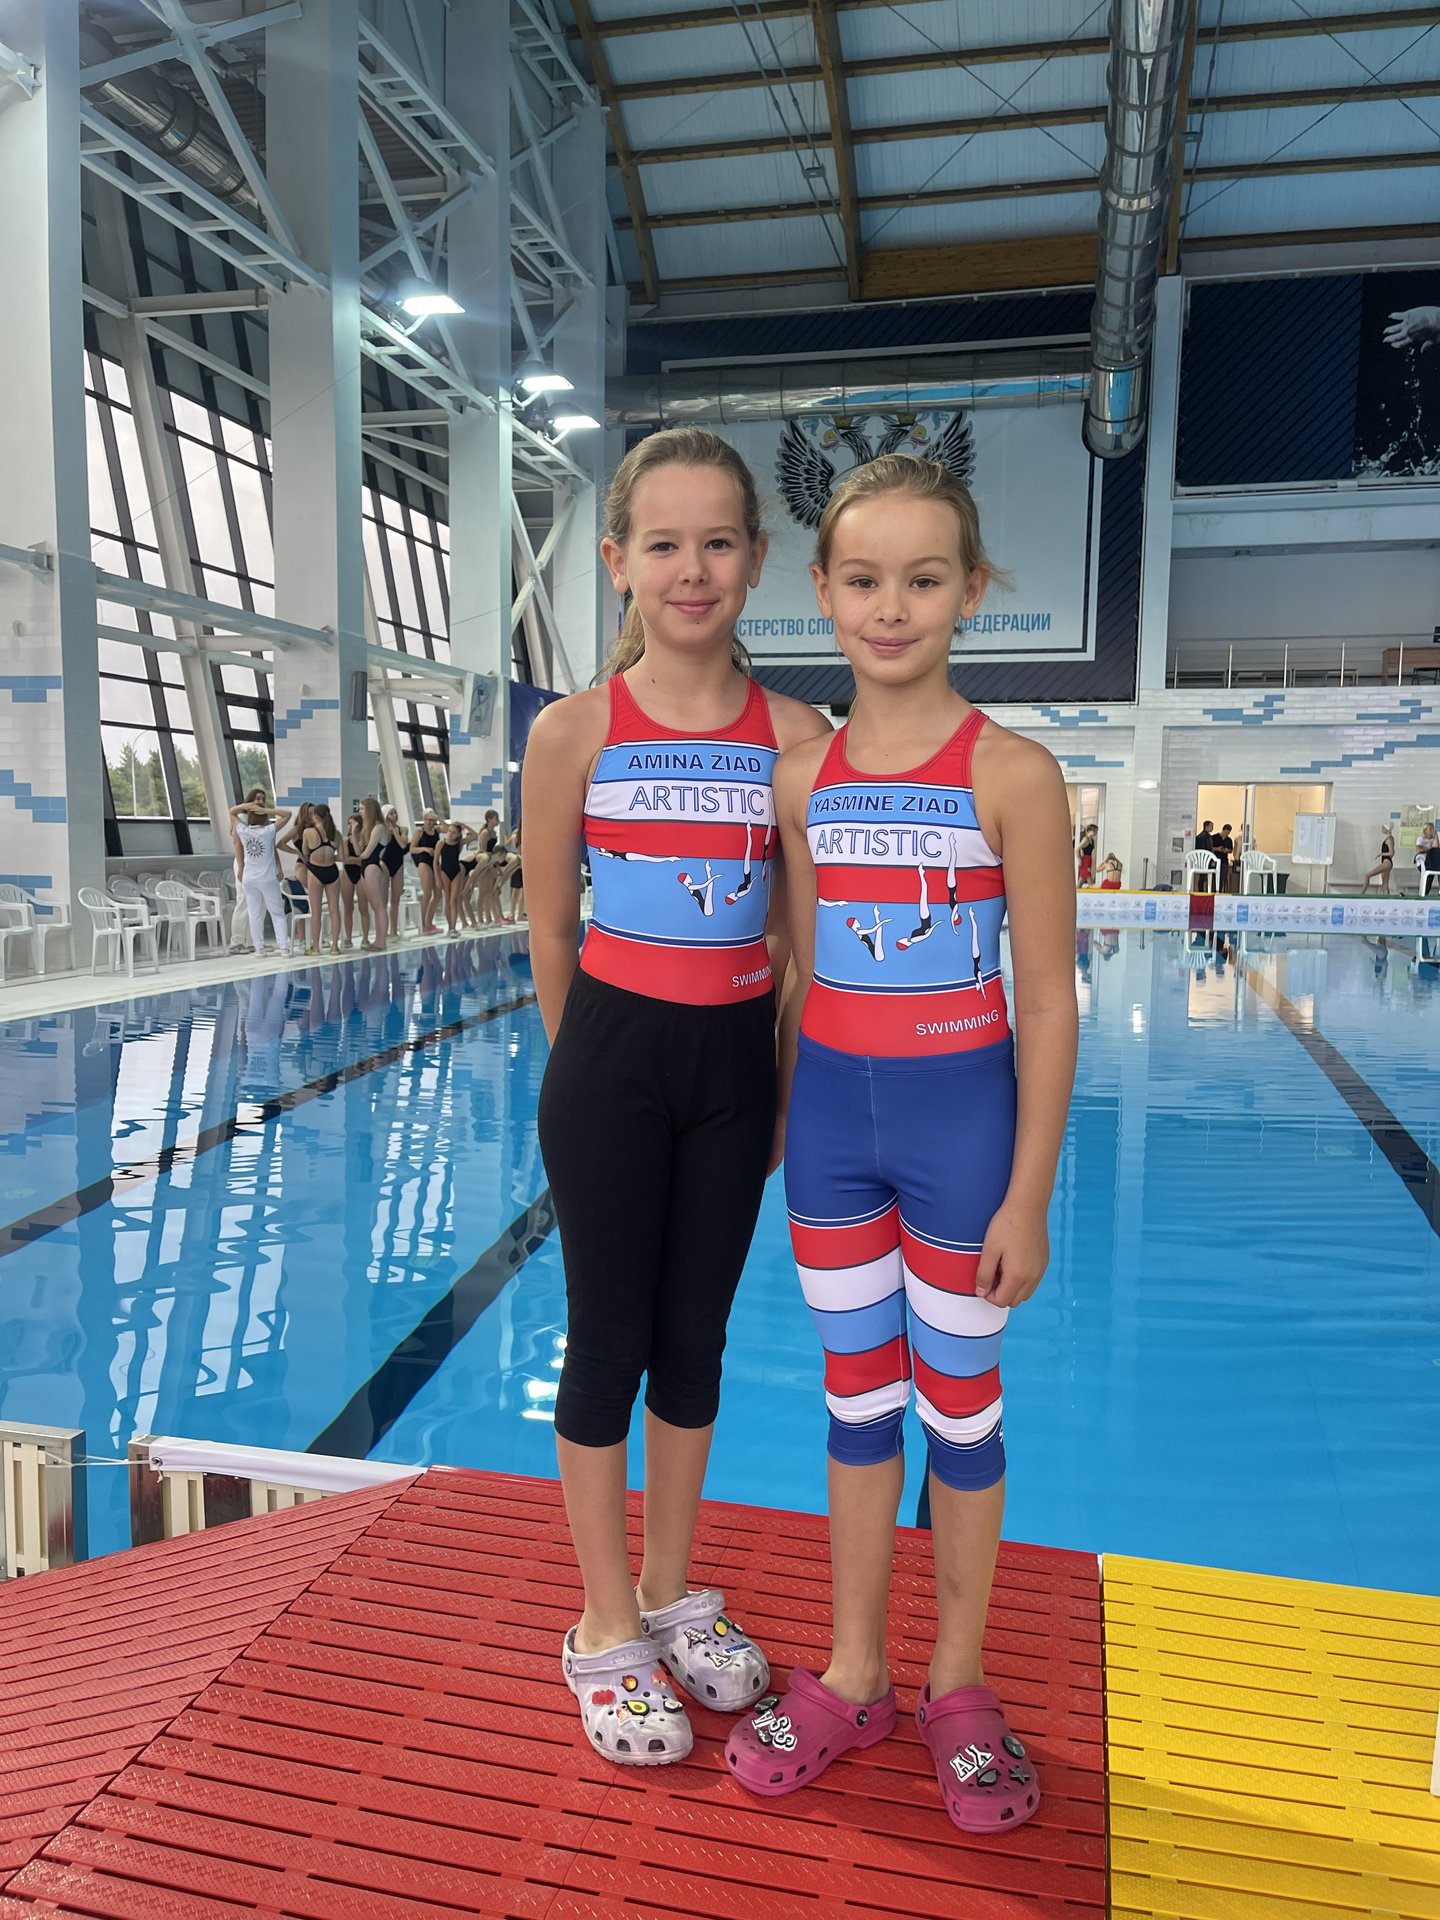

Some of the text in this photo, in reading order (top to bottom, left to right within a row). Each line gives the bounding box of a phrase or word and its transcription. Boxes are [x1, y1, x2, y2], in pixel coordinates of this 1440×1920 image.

[736, 618, 804, 636] СТЕРСТВО
[959, 613, 1051, 634] ФЕДЕРАЦИИ
[627, 754, 761, 773] AMINA ZIAD
[628, 785, 765, 816] ARTISTIC
[813, 795, 960, 815] YASMINE ZIAD
[815, 828, 942, 858] ARTISTIC
[915, 1009, 999, 1035] SWIMMING
